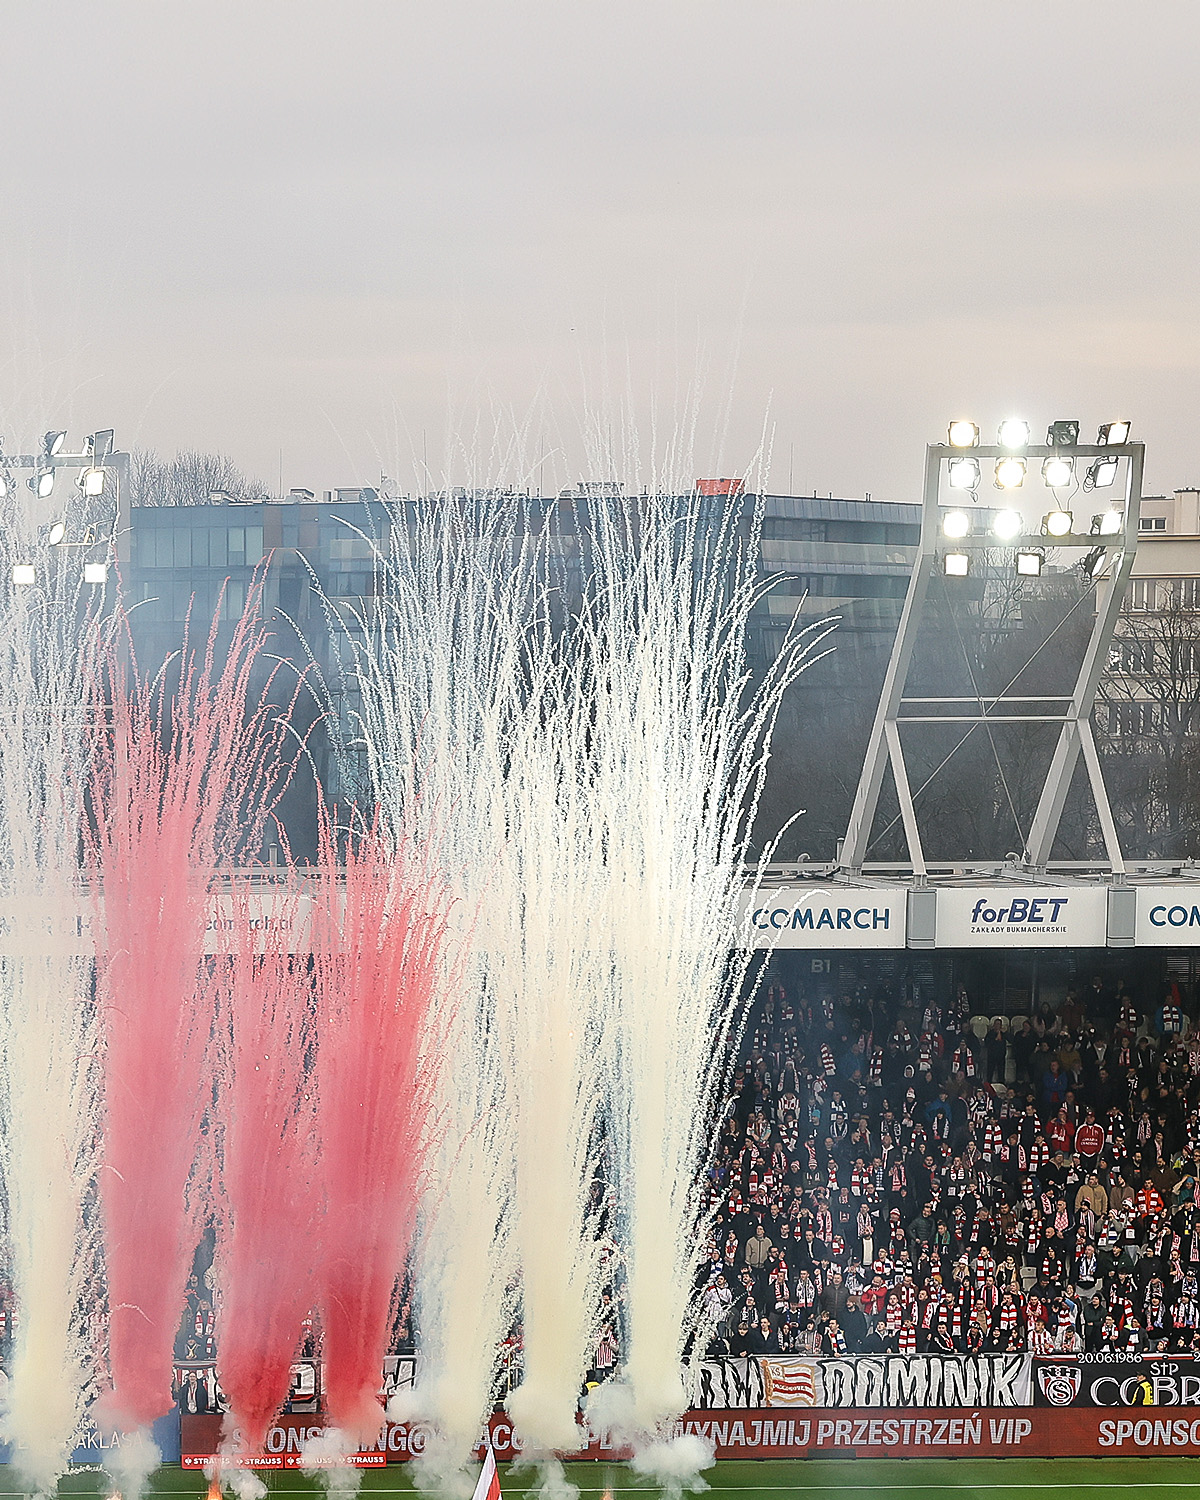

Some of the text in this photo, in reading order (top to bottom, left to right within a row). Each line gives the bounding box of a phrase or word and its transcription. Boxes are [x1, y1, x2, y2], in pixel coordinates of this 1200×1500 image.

[751, 906, 891, 931] COMARCH
[970, 898, 1068, 924] forBET
[970, 926, 1068, 934] ZAKŁADY BUKMACHERSKIE
[821, 1356, 1019, 1406] DOMINIK
[818, 1412, 982, 1446] PRZESTRZEŃ
[989, 1419, 1032, 1445] VIP
[244, 1457, 282, 1465] STRAUSS
